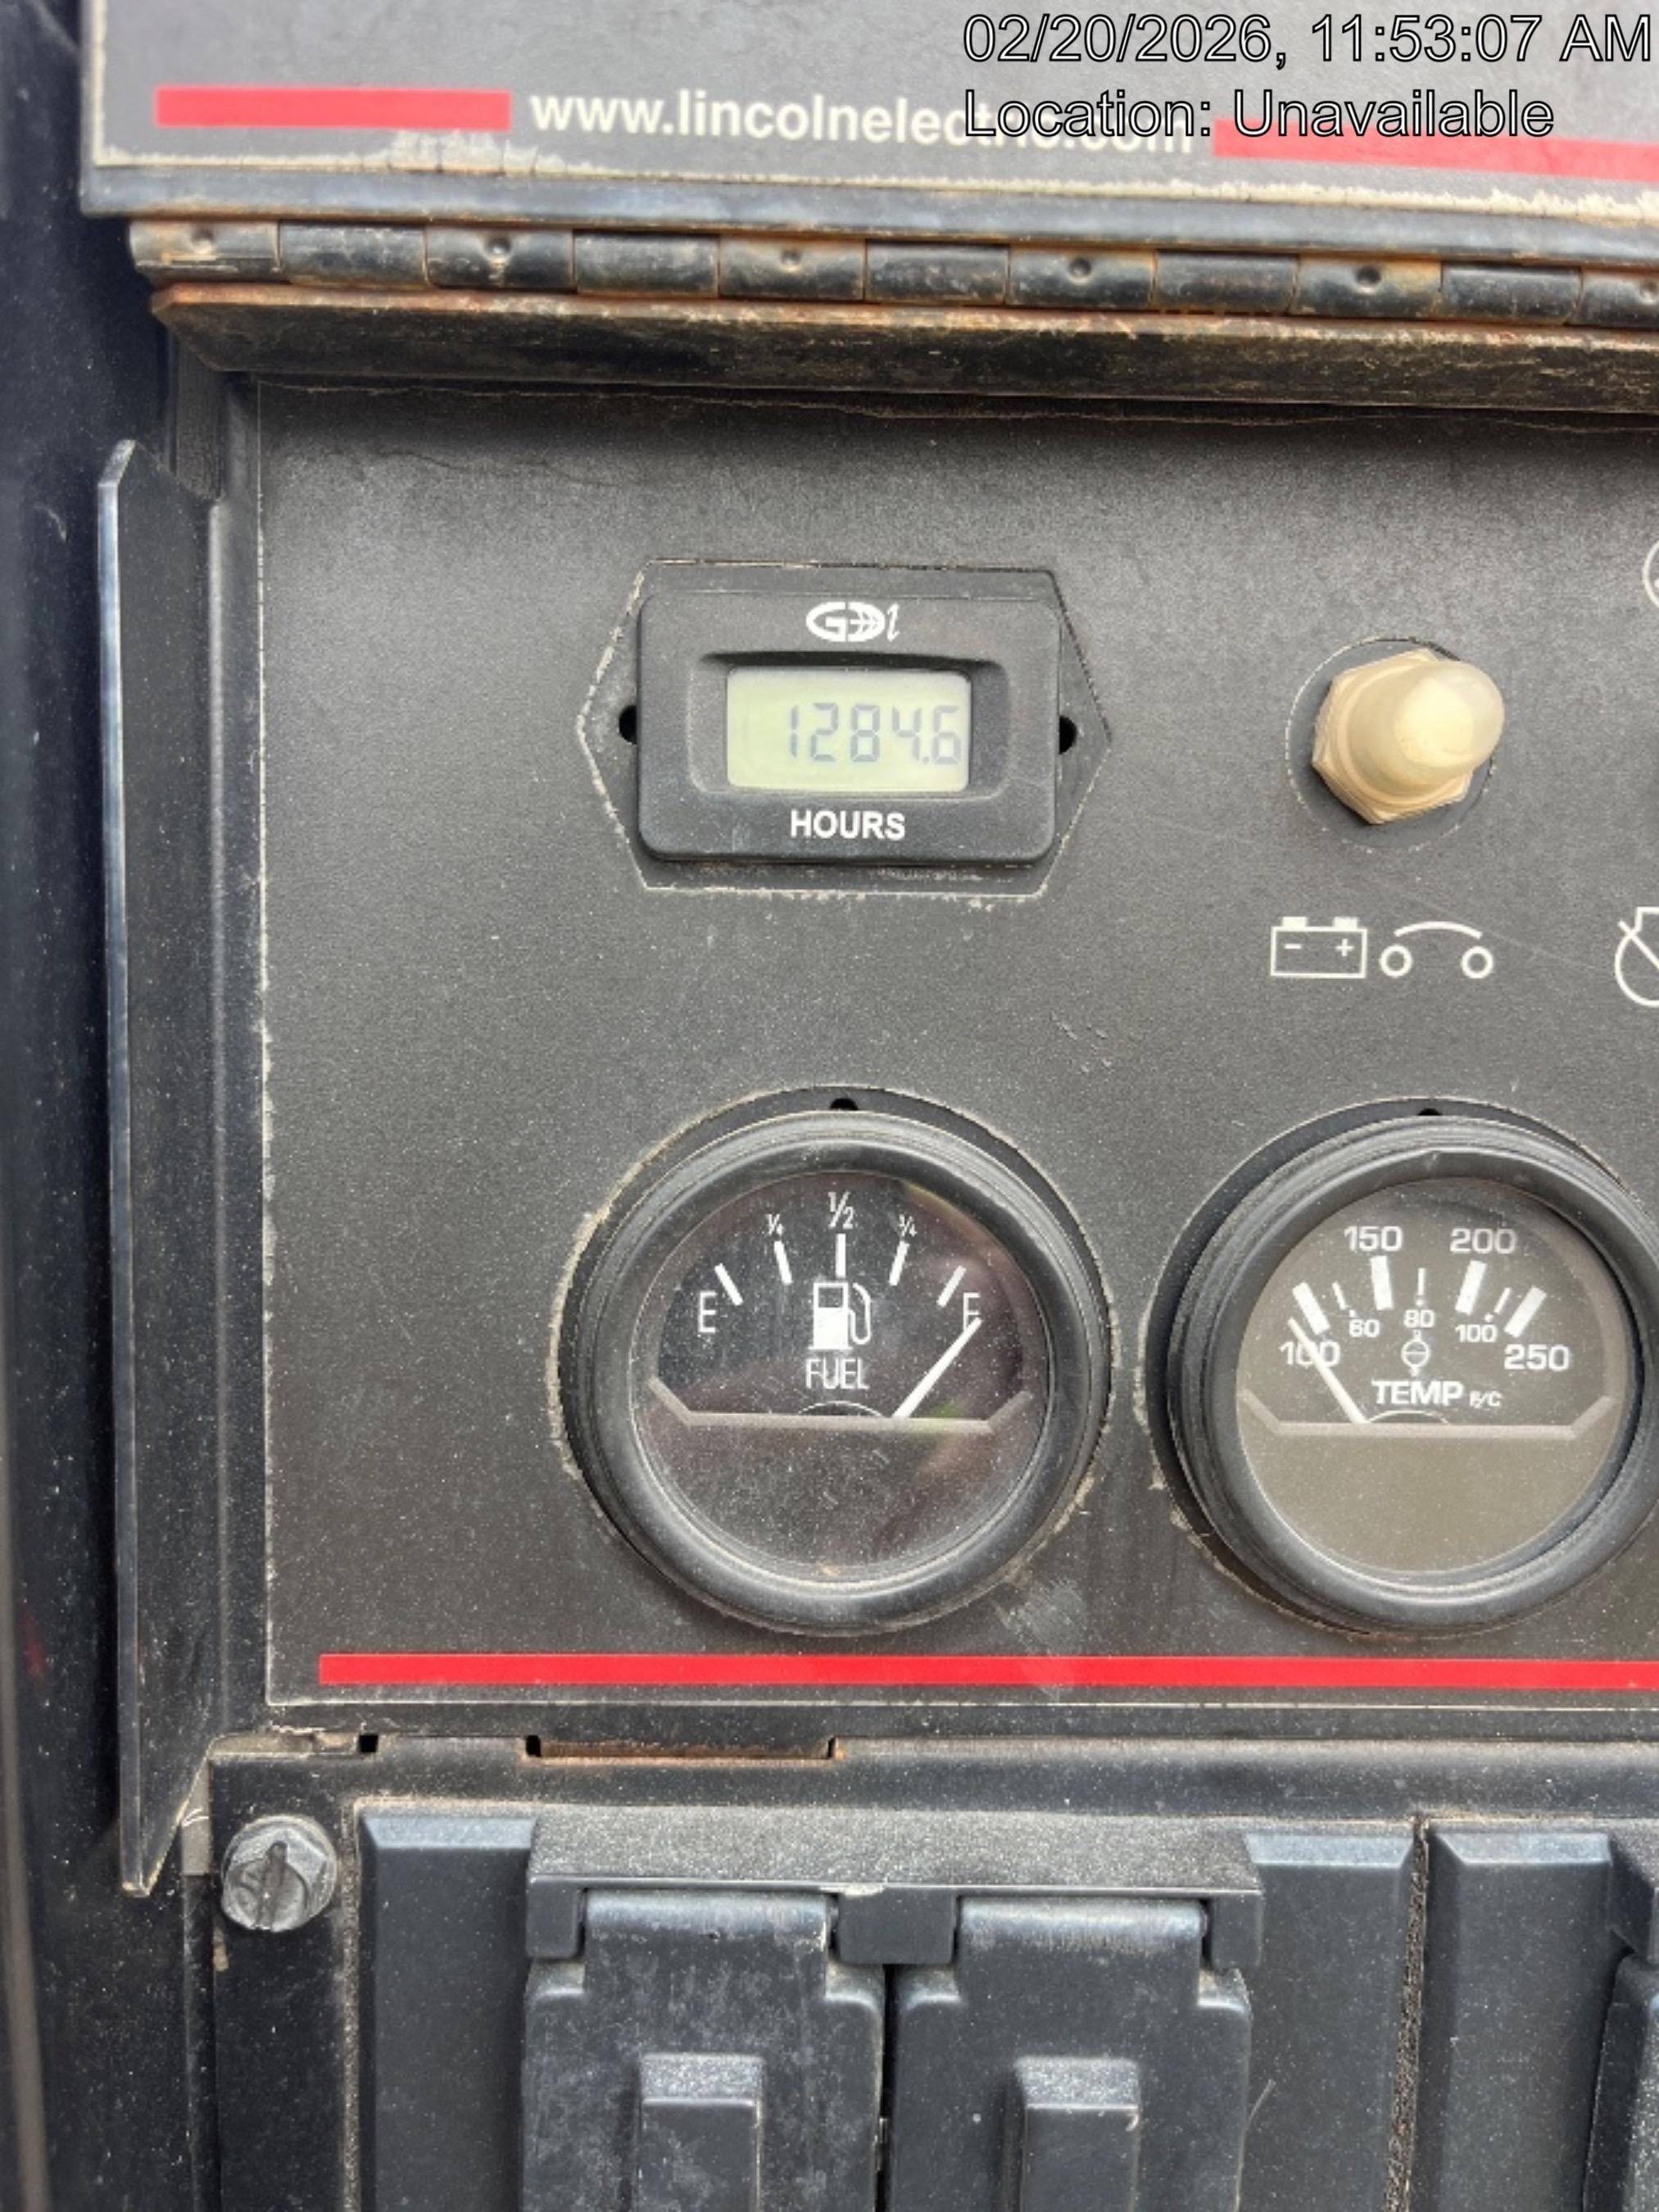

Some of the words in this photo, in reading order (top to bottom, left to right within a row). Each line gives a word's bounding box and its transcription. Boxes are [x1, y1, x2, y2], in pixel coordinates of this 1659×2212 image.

[788, 702, 962, 765] 1284.6
[790, 809, 906, 840] HOURS
[1344, 1226, 1403, 1252] 150
[1449, 1228, 1516, 1254] 200
[697, 1291, 717, 1334] E
[962, 1292, 981, 1330] F
[1403, 1309, 1435, 1329] 80
[1455, 1324, 1498, 1343] 100
[1279, 1341, 1340, 1367] 100
[1504, 1344, 1570, 1371] 250
[805, 1358, 869, 1390] FUEL
[1371, 1380, 1464, 1406] TEMP
